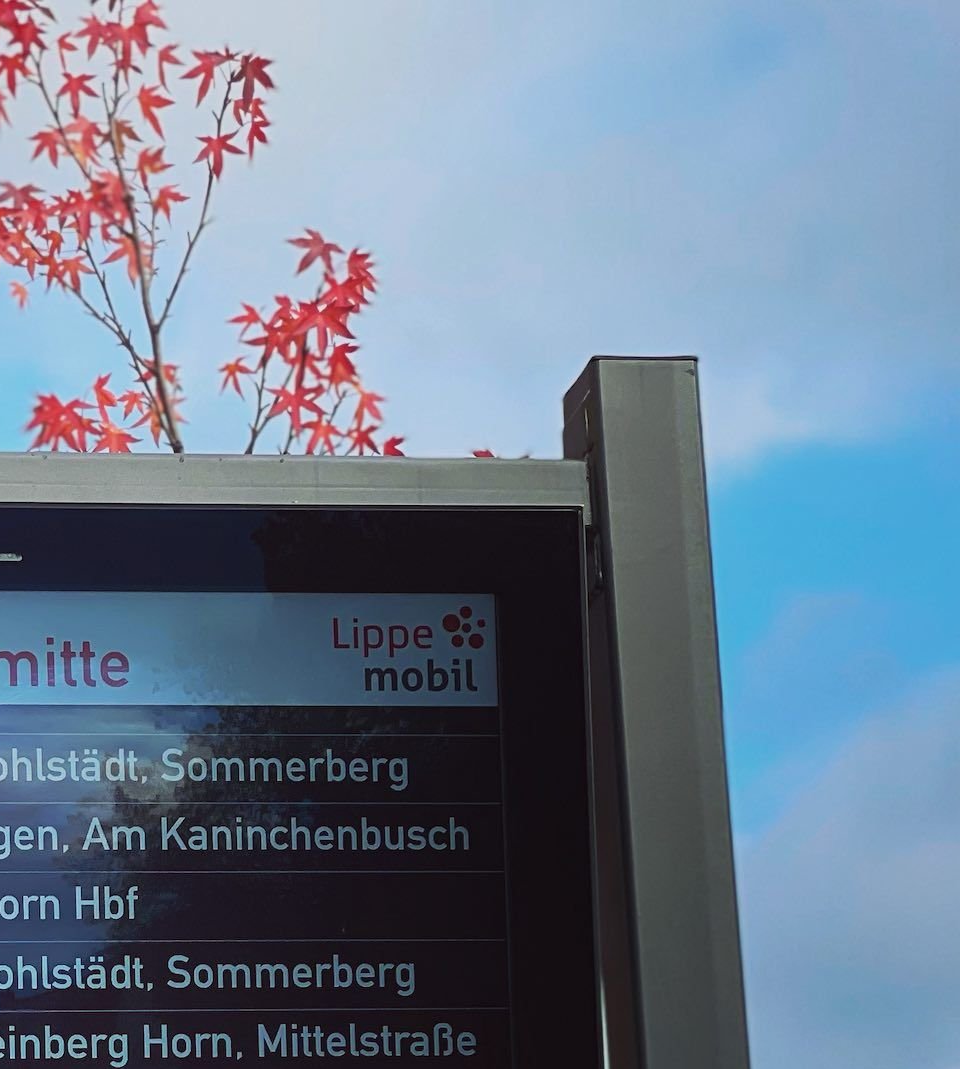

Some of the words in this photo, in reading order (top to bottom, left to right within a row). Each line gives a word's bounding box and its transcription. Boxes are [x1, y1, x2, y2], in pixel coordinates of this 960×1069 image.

[332, 616, 434, 657] Lippe
[363, 658, 478, 692] mobil
[160, 748, 409, 791] Sommerberg
[81, 816, 146, 851] Am
[160, 816, 470, 851] Kaninchenbusch
[74, 885, 139, 920] Hbf
[166, 954, 416, 997] Sommerberg
[143, 1023, 243, 1061] Horn,
[257, 1022, 477, 1058] Mittelstraße
